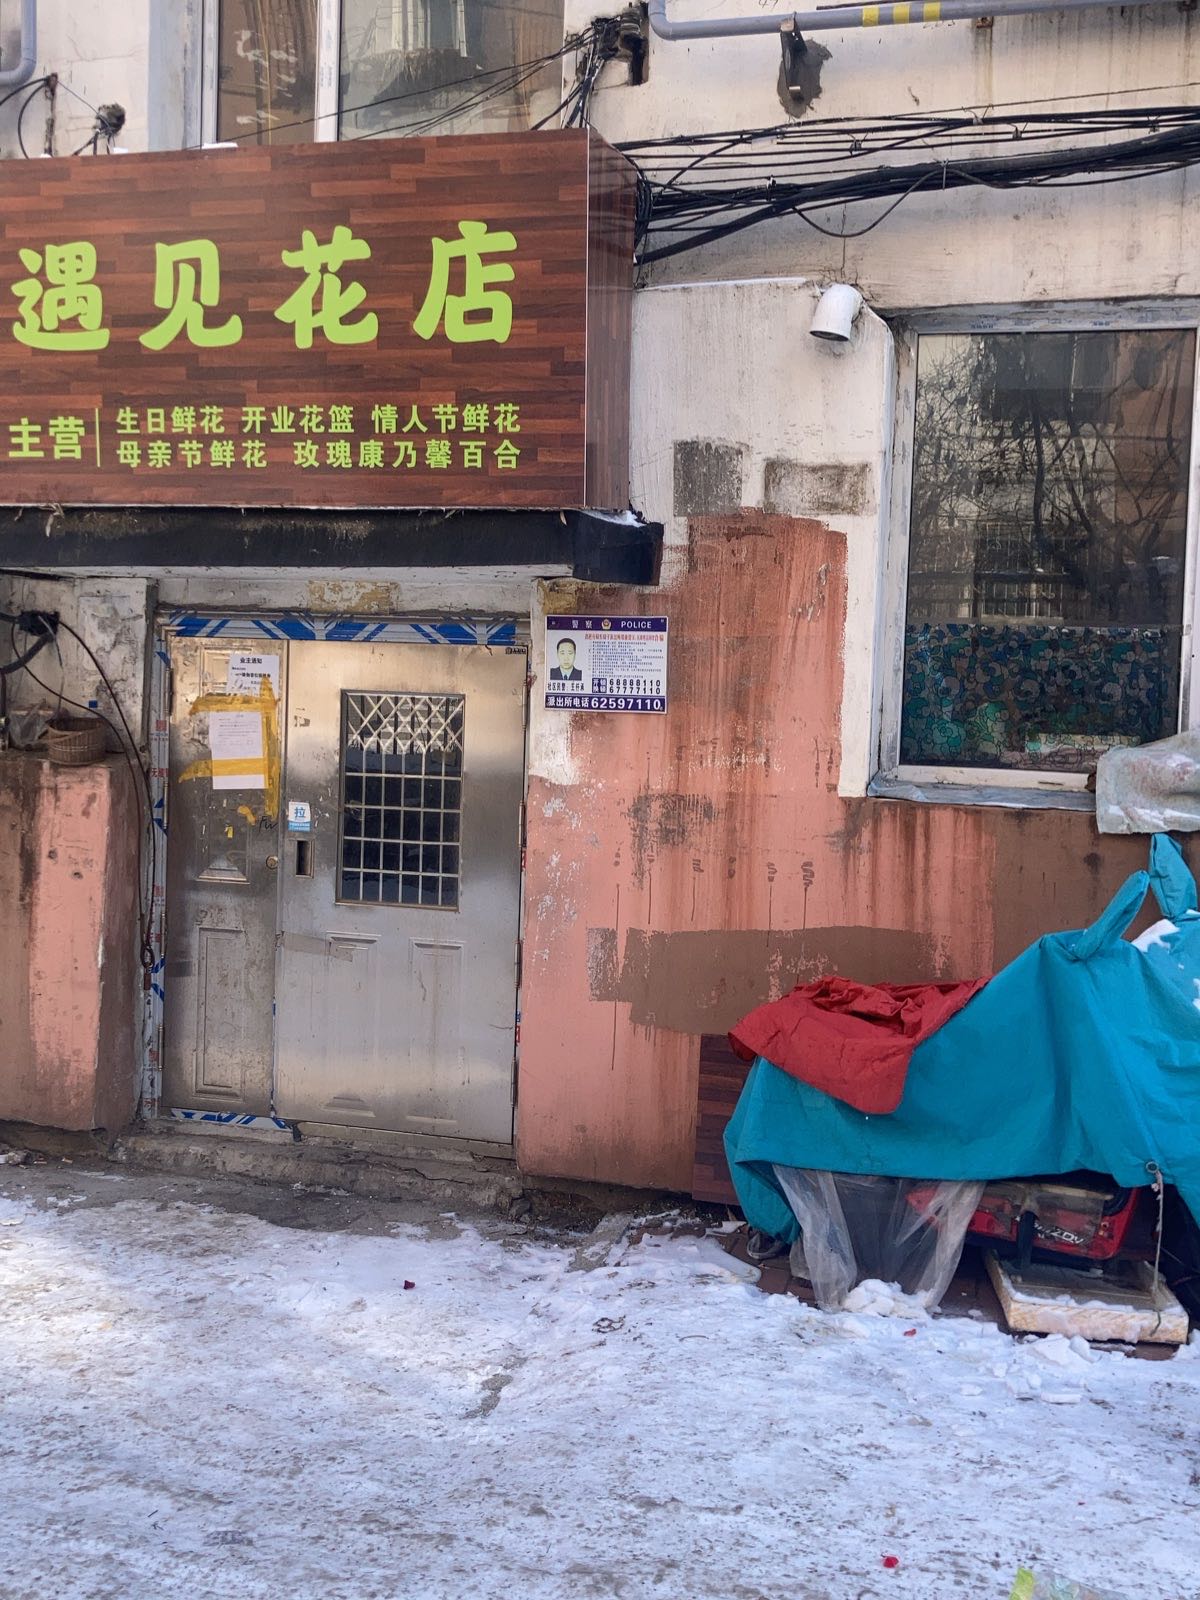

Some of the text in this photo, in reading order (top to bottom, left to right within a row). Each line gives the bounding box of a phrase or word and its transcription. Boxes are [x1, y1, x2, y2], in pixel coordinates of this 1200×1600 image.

[11, 221, 517, 351] 遇见花店
[117, 403, 521, 434] 生日鲜花 开业花篮 情人节鲜花
[8, 416, 85, 460] 主营
[117, 439, 521, 469] 母亲节鲜花 玫瑰康乃馨百合
[621, 620, 652, 629] POLICE
[609, 679, 661, 687] 68888110
[591, 698, 661, 711] 62597110
[294, 807, 305, 818] 拉
